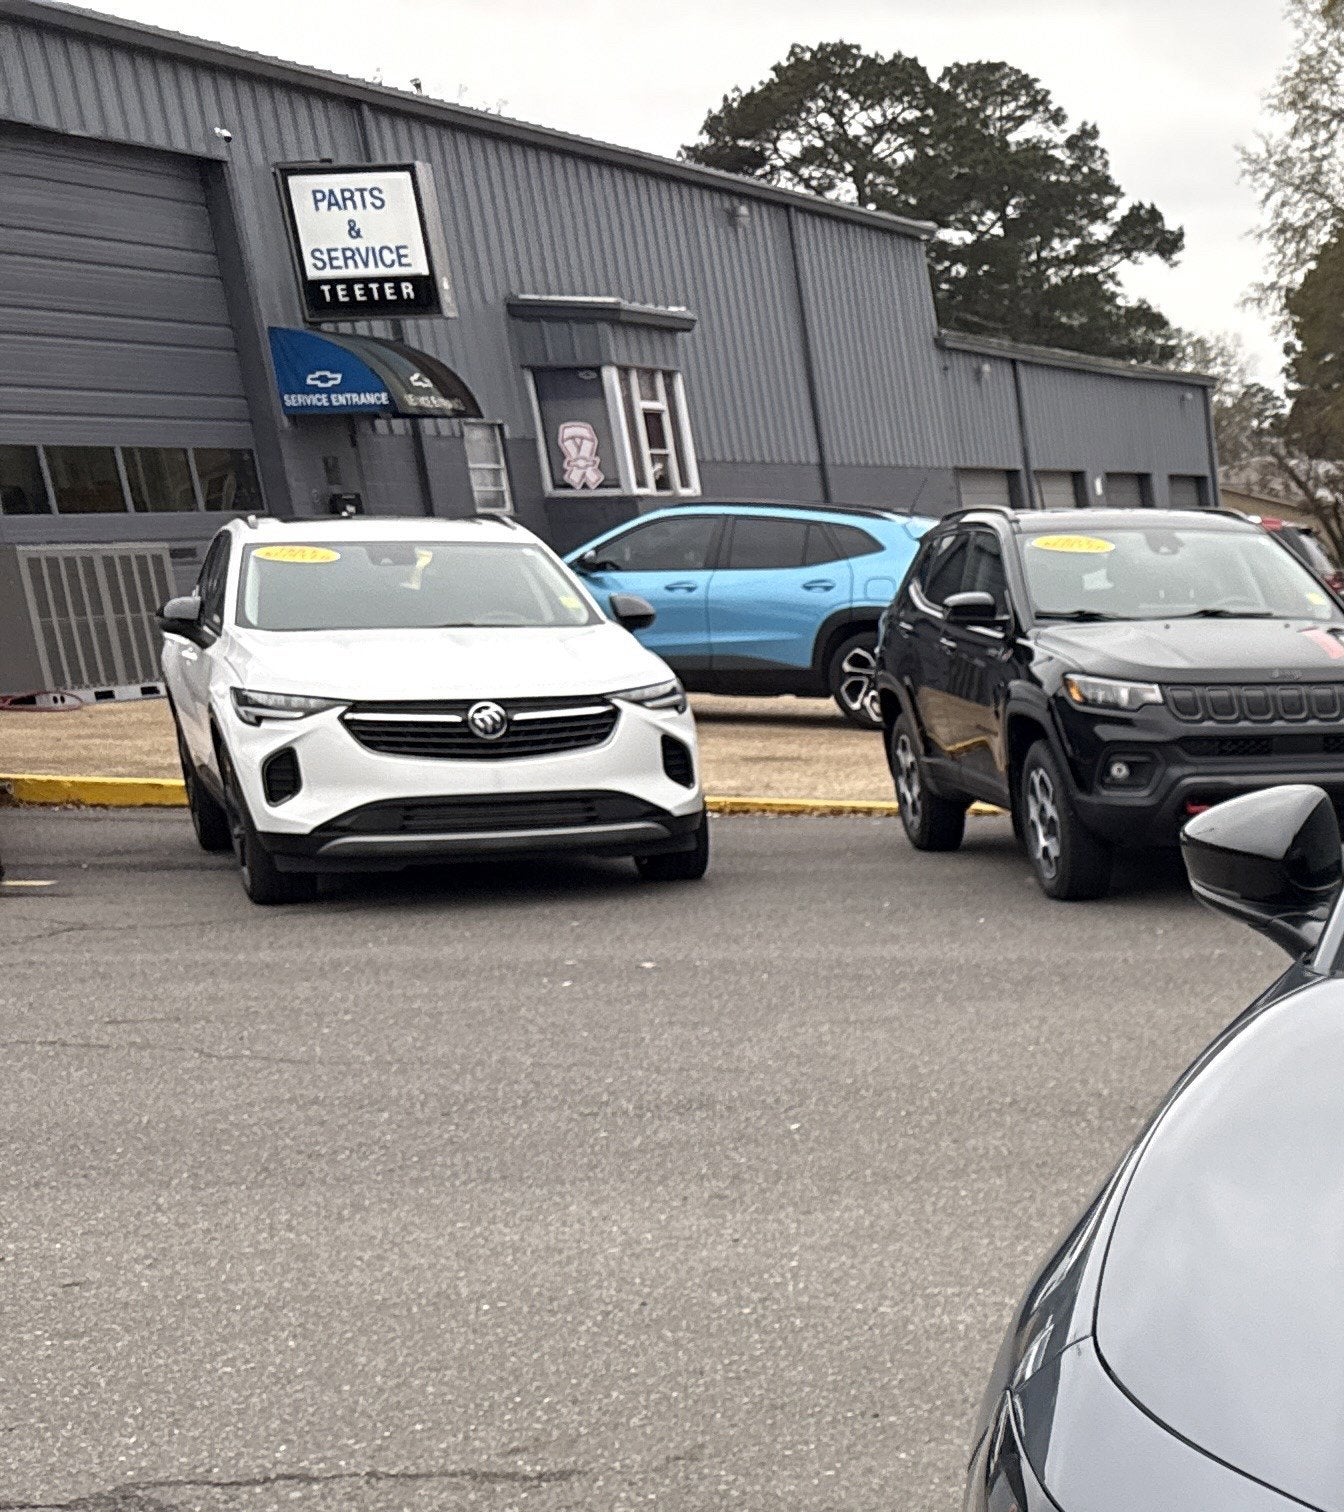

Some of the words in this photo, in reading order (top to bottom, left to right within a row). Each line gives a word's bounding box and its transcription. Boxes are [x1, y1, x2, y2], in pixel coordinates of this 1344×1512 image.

[311, 186, 386, 212] PARTS
[347, 218, 363, 239] &
[310, 245, 412, 271] SERVICE
[320, 281, 415, 302] TEETER
[283, 393, 330, 407] SERVICE
[330, 391, 390, 406] ENTRANCE
